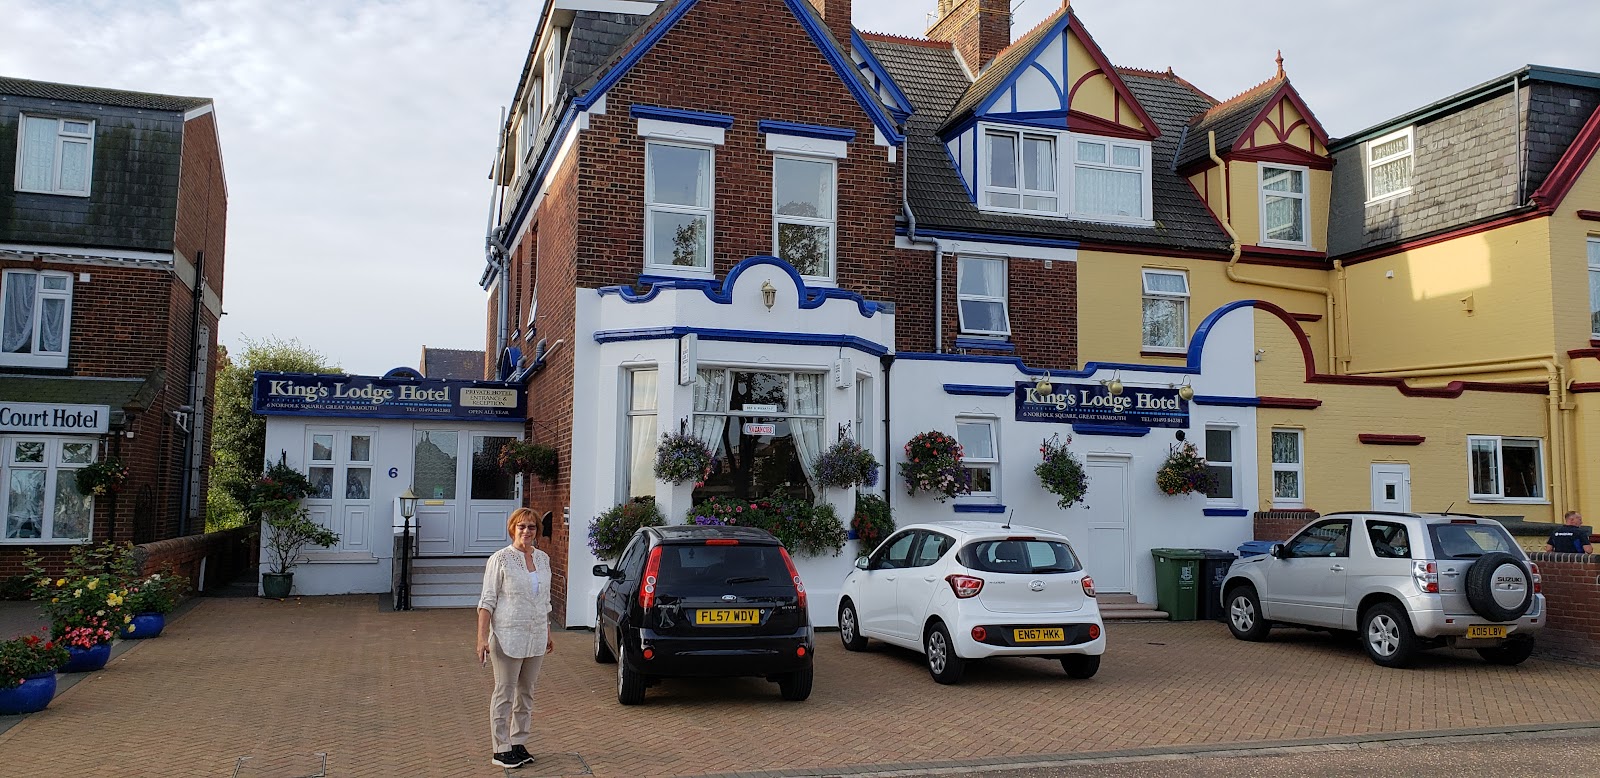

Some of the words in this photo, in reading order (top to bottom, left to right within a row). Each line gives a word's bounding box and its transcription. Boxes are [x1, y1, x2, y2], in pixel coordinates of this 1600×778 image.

[268, 380, 328, 402] King's
[333, 382, 393, 404] Lodge
[398, 384, 450, 401] Hotel
[1024, 387, 1076, 410] King's
[1080, 389, 1131, 413] Lodge
[1136, 392, 1180, 410] Hotel
[0, 407, 49, 427] Court
[52, 408, 98, 428] Hotel
[388, 467, 399, 479] 6
[701, 610, 731, 622] FL57
[733, 610, 755, 621] WDV
[1018, 628, 1041, 640] EN67
[1043, 629, 1061, 639] HKK
